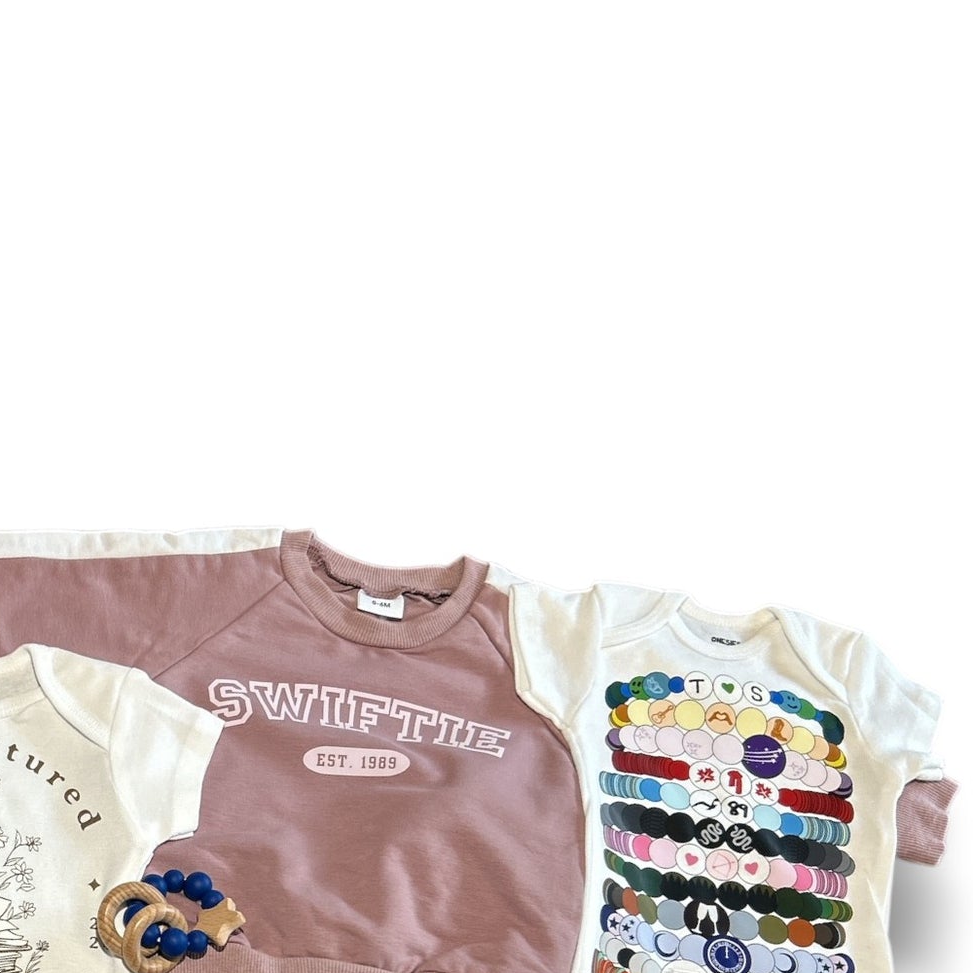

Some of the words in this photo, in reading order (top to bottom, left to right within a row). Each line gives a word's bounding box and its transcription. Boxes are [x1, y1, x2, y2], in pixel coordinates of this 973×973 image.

[688, 678, 705, 694] T
[750, 685, 764, 702] S
[208, 677, 512, 759] SWIFTIE
[316, 754, 353, 770] EST.
[361, 755, 397, 770] 1989
